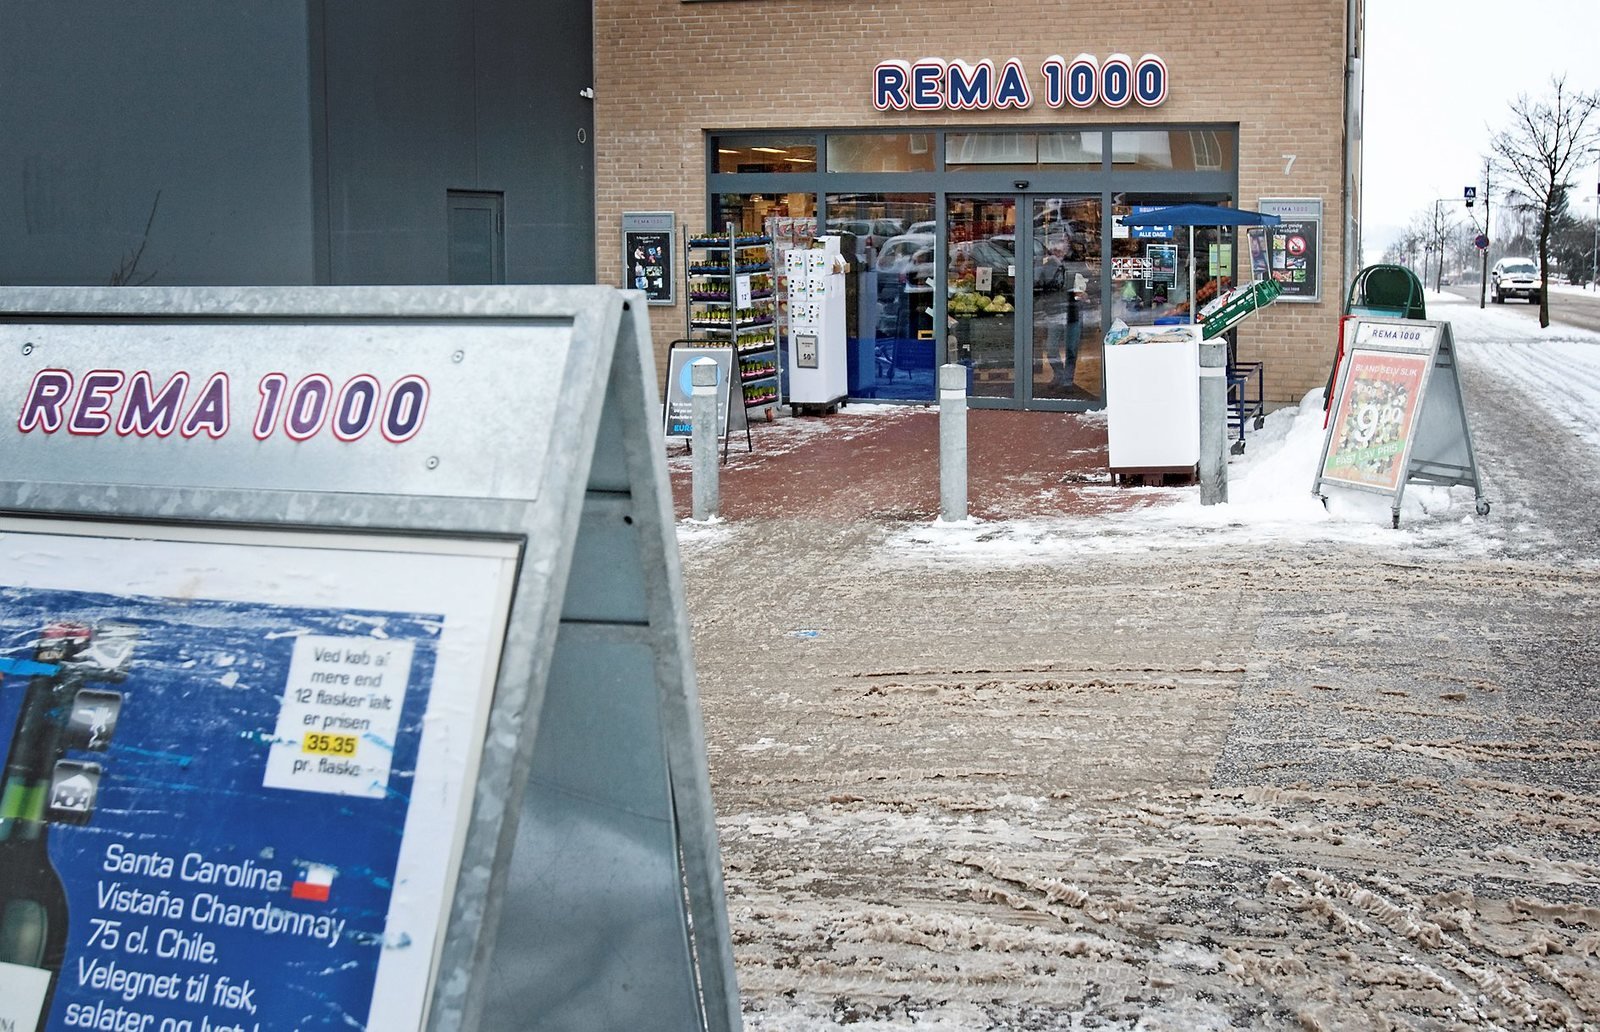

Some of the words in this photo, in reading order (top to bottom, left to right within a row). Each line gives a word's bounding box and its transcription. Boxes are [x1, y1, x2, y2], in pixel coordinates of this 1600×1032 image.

[872, 58, 1033, 111] REMA
[1041, 54, 1169, 109] 1000
[1282, 155, 1297, 176] 7
[1372, 329, 1397, 339] REMA
[1399, 331, 1421, 341] 1000
[1400, 368, 1418, 377] SLIK
[18, 368, 229, 439] REMA
[253, 373, 431, 444] 1000
[1336, 453, 1356, 466] FAST
[1378, 444, 1398, 454] PRIS
[314, 648, 341, 662] Ved
[310, 672, 350, 686] mere
[354, 673, 383, 688] end
[295, 688, 313, 704] 12
[316, 689, 366, 709] flasker
[303, 714, 320, 726] er
[322, 713, 371, 731] prisen
[307, 734, 357, 754] 35.35
[292, 758, 313, 775] pr.
[104, 843, 174, 879] Santa
[180, 852, 283, 892] Carolina
[97, 880, 184, 920] Vistaña
[190, 892, 346, 948] Chardonnay
[86, 918, 123, 951] 75
[125, 925, 150, 956] cl.
[156, 928, 220, 965] Chile.
[78, 956, 181, 1002] Velegnet
[186, 974, 210, 1004] til
[213, 976, 258, 1016] fisk,
[64, 999, 155, 1032] salater
